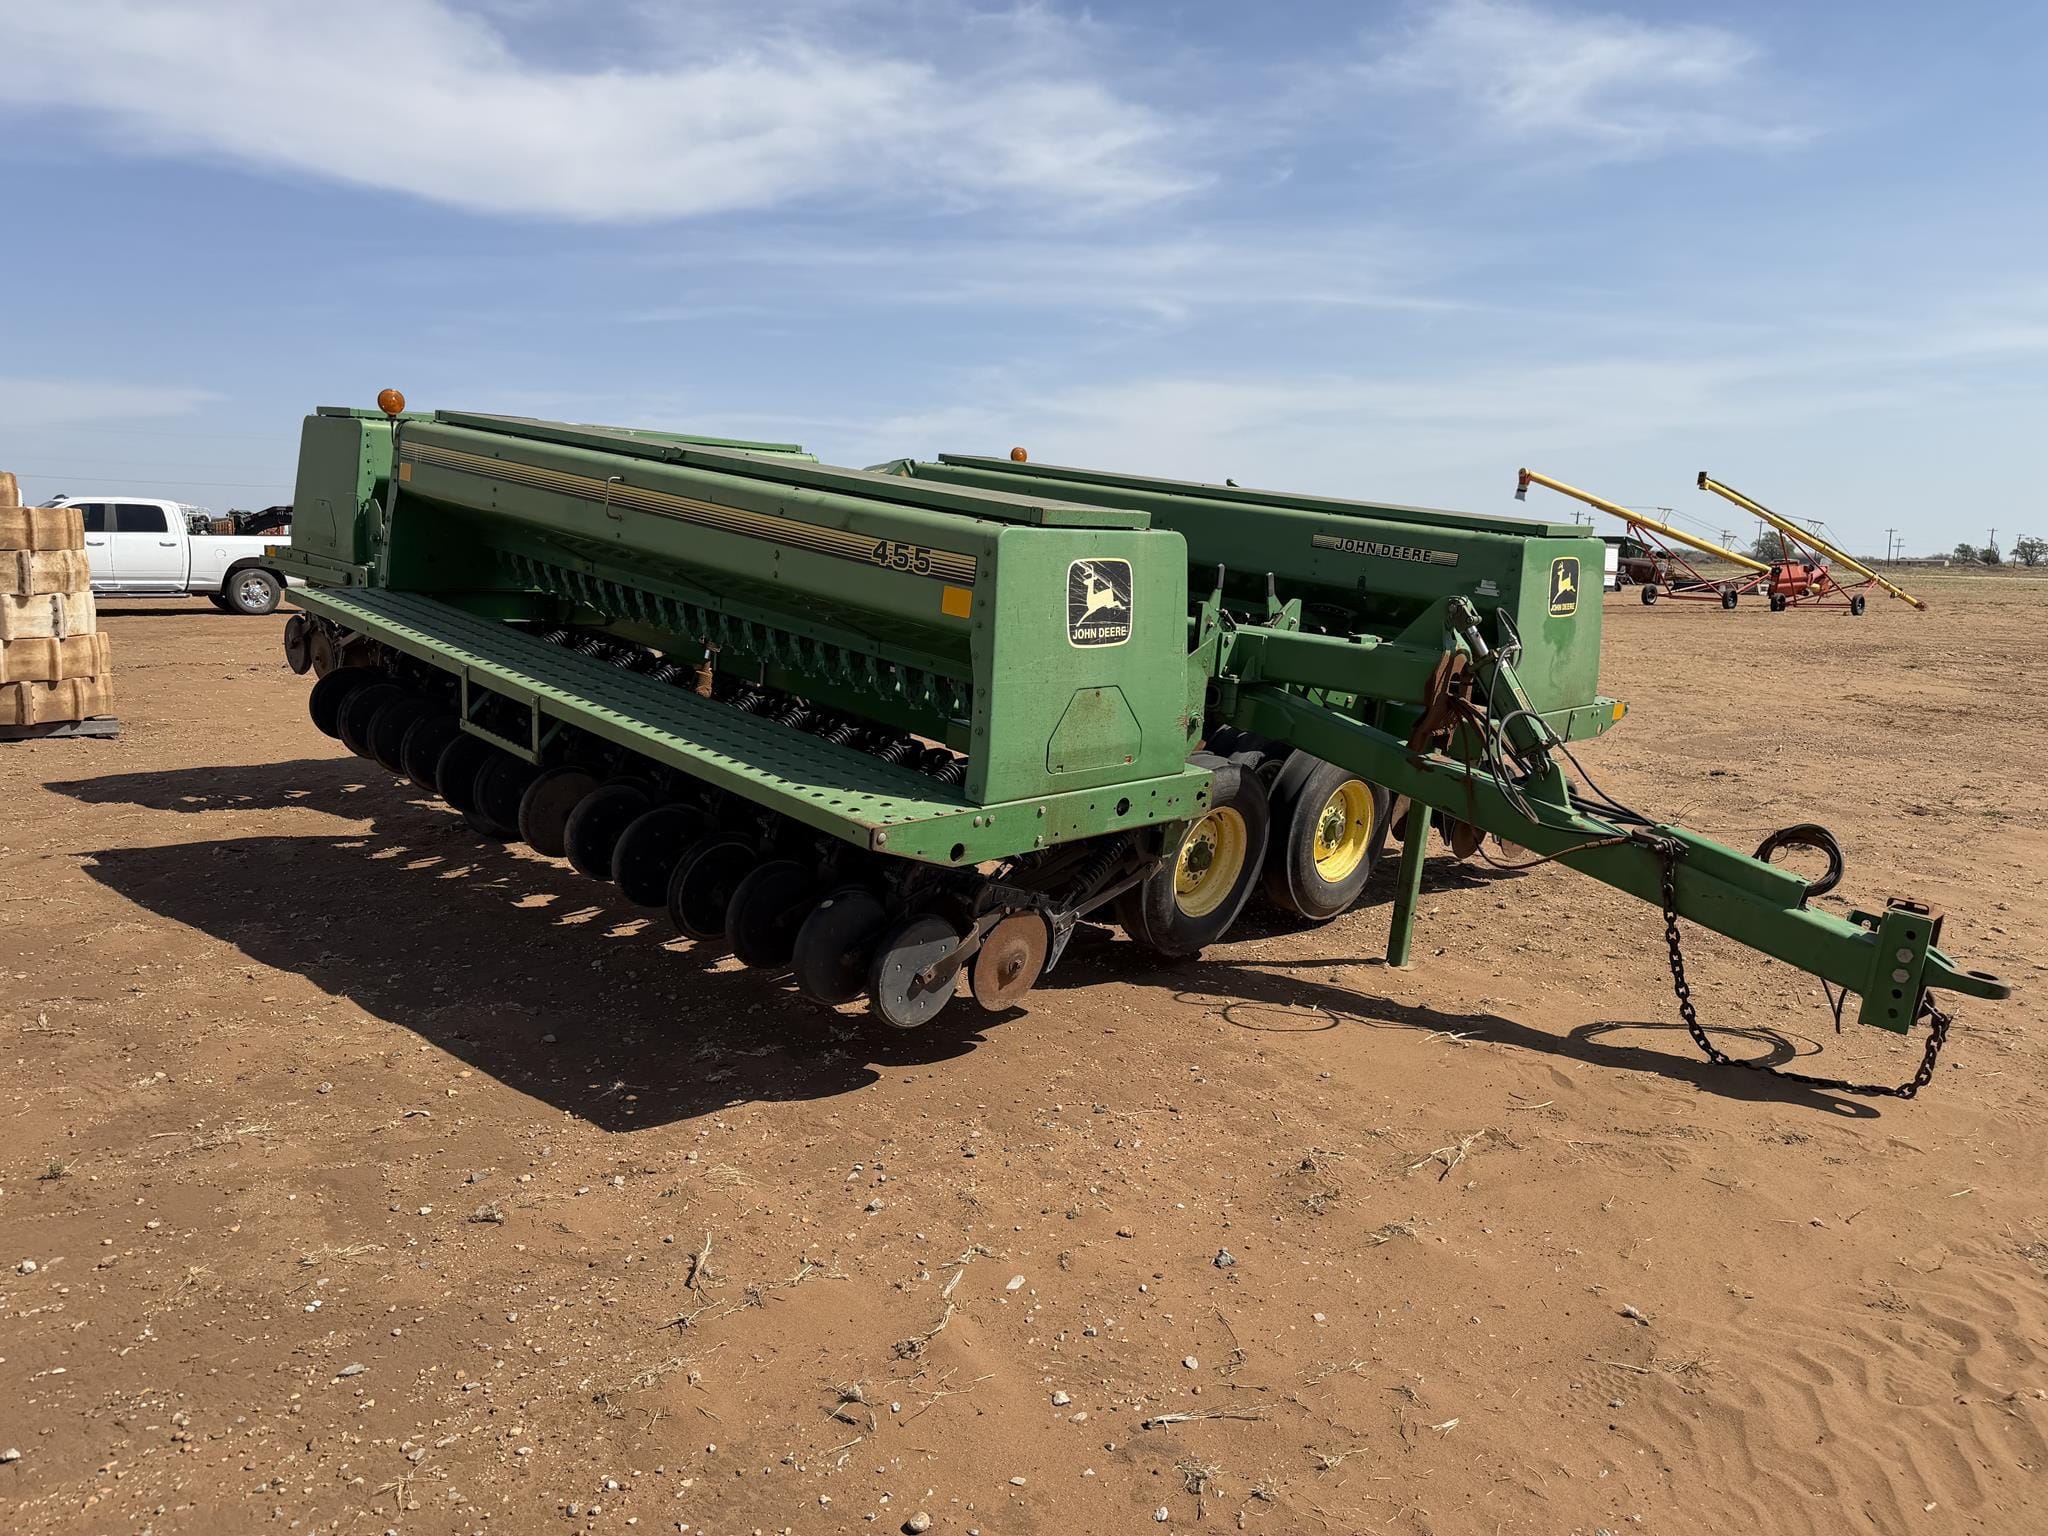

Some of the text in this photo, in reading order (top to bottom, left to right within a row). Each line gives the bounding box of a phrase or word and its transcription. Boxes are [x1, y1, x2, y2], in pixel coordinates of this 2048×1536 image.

[872, 540, 931, 575] 455
[1335, 538, 1432, 562] JOHN DEERE
[1072, 625, 1127, 640] JOHN DEERE
